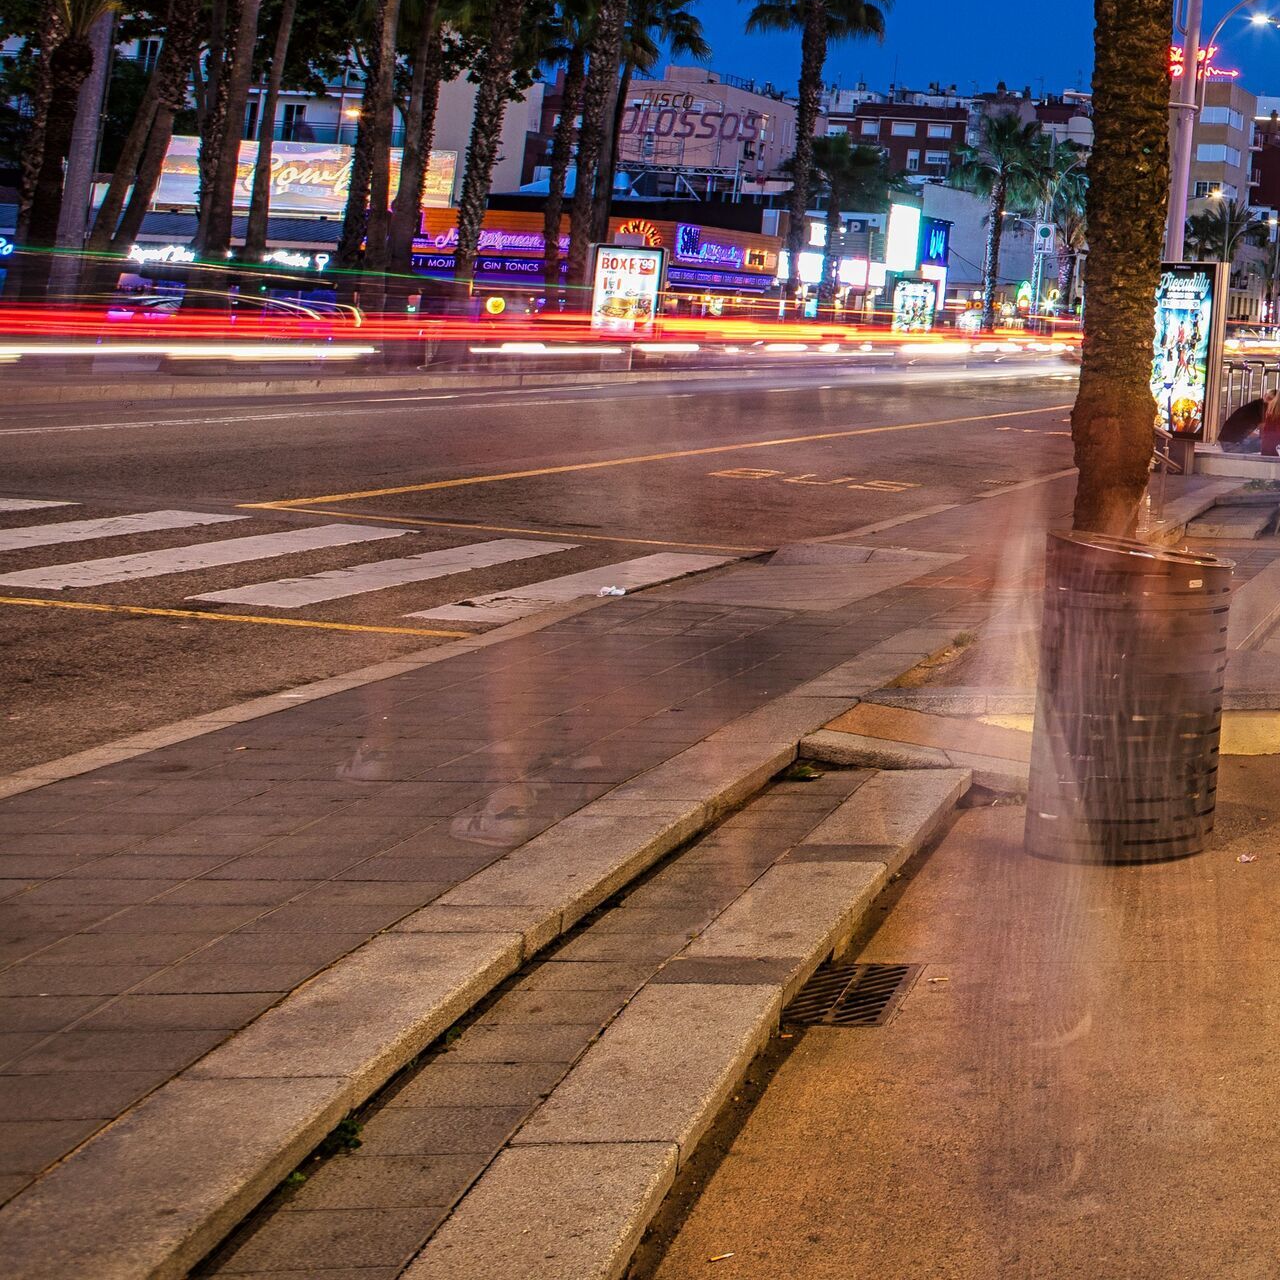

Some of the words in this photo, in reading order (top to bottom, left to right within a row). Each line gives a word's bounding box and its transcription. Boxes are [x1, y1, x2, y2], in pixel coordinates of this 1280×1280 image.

[642, 92, 694, 109] DISCO
[620, 106, 762, 141] OLOSSOS
[483, 261, 501, 270] GIN
[505, 262, 539, 271] TONICS
[602, 257, 628, 270] BOX
